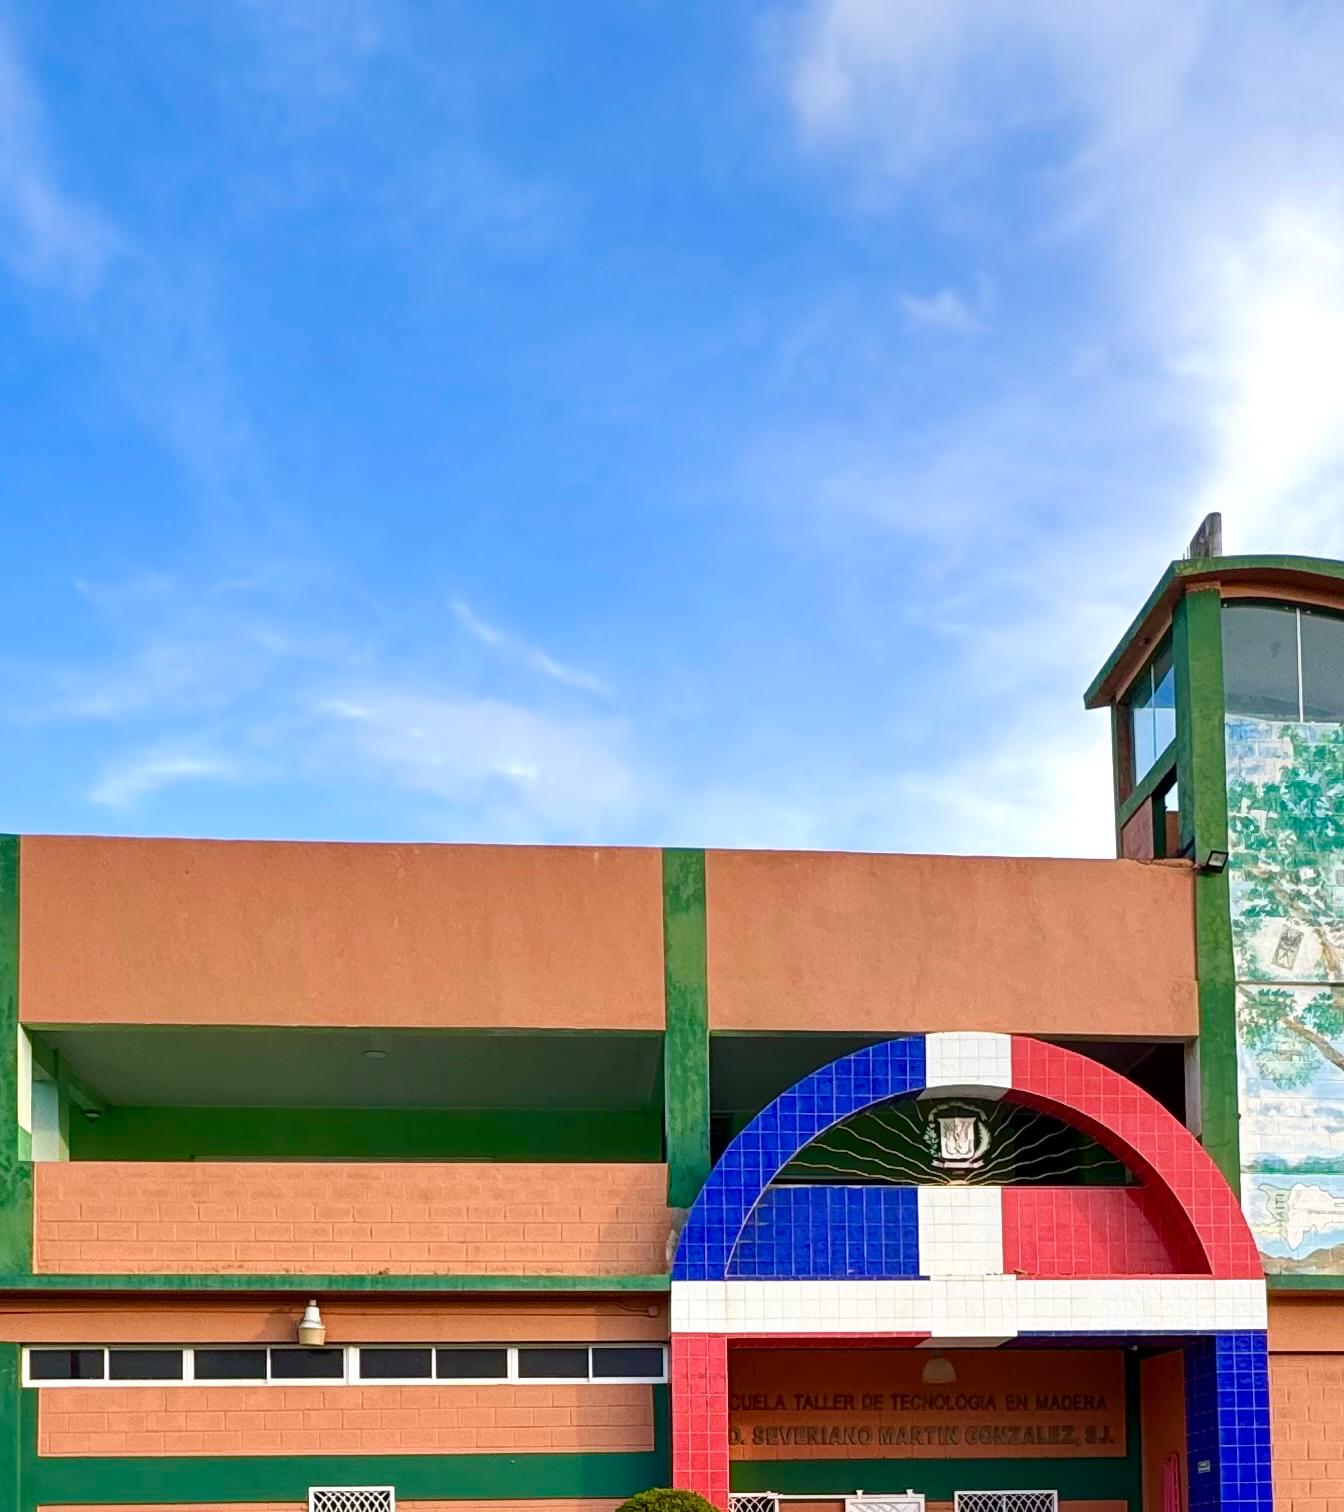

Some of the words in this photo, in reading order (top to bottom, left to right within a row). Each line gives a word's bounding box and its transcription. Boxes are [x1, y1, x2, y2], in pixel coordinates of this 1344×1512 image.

[794, 1392, 855, 1411] TALLER
[862, 1393, 884, 1411] DE
[890, 1392, 995, 1411] TECNOLOGIA
[1005, 1393, 1028, 1411] EN
[1036, 1393, 1108, 1411] MADERA
[752, 1424, 872, 1446] SEVERIANO
[878, 1424, 960, 1446] MARTIN
